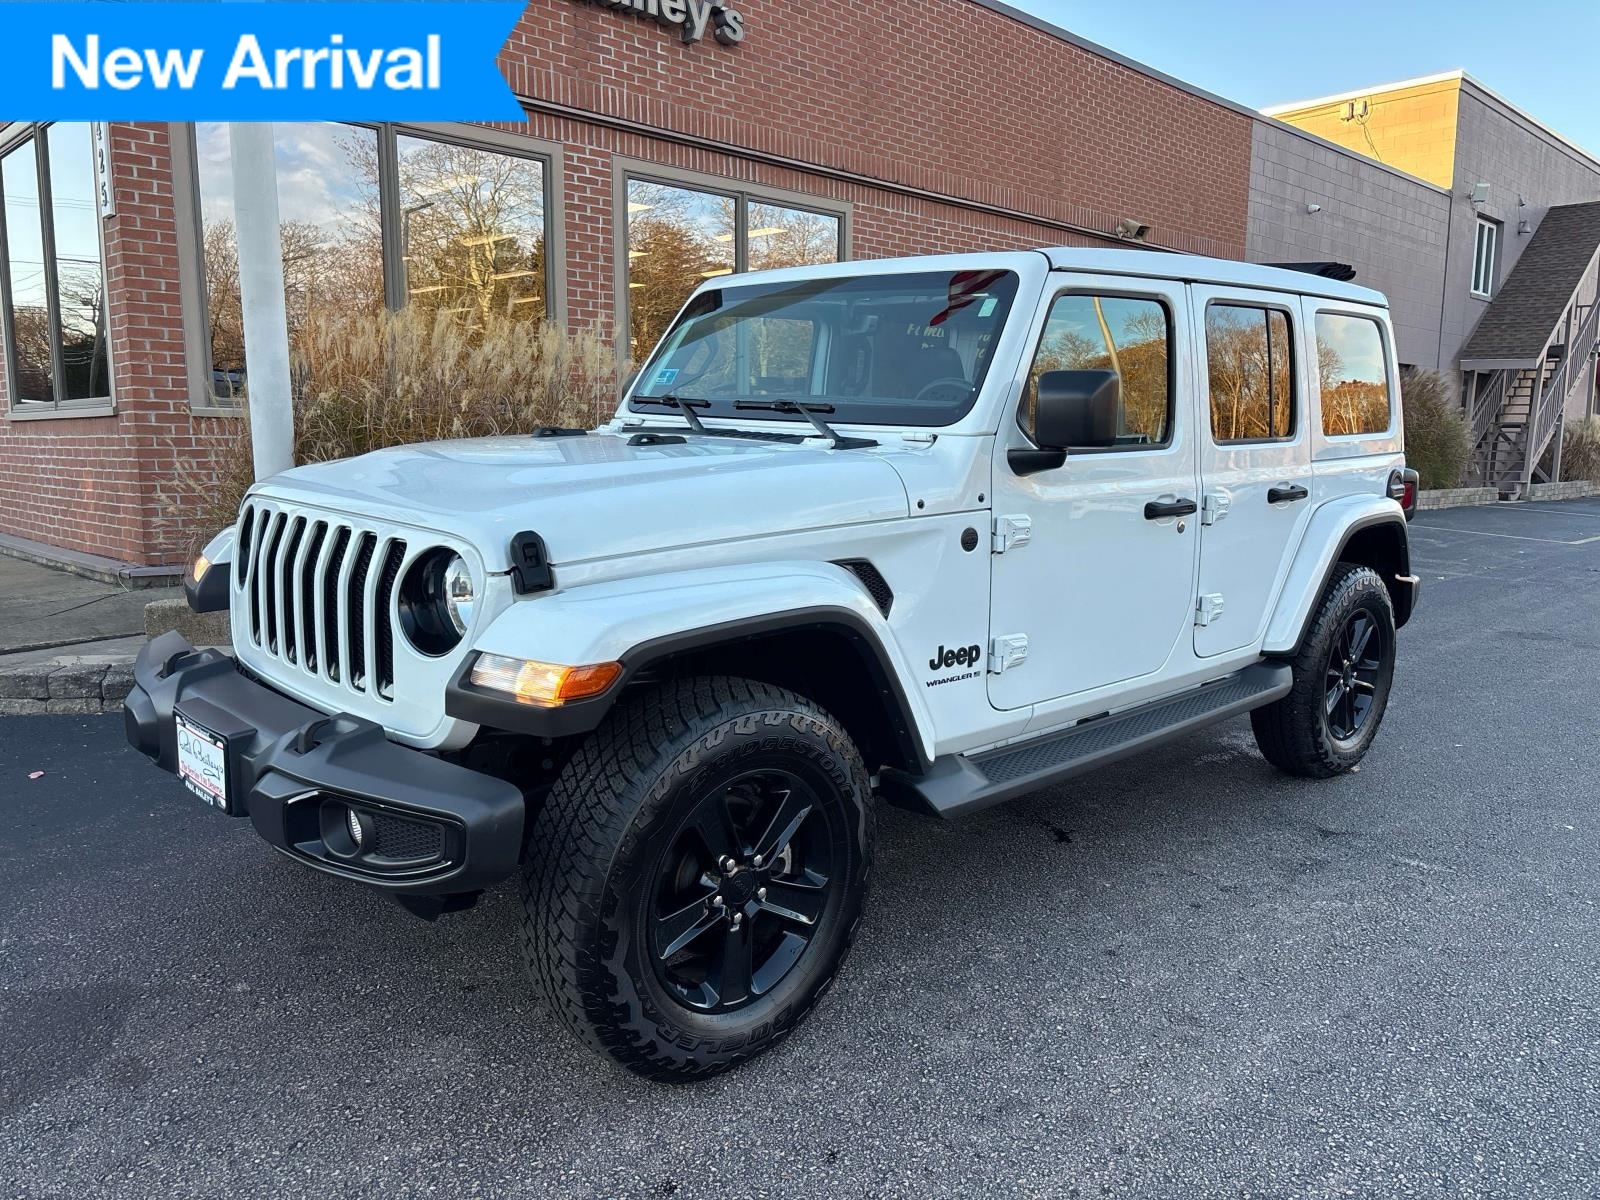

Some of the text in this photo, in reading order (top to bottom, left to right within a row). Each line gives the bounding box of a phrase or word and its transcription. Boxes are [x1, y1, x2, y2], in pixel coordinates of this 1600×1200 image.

[606, 0, 744, 42] ey's
[929, 644, 980, 671] Jeep
[926, 672, 973, 687] WRANGLER
